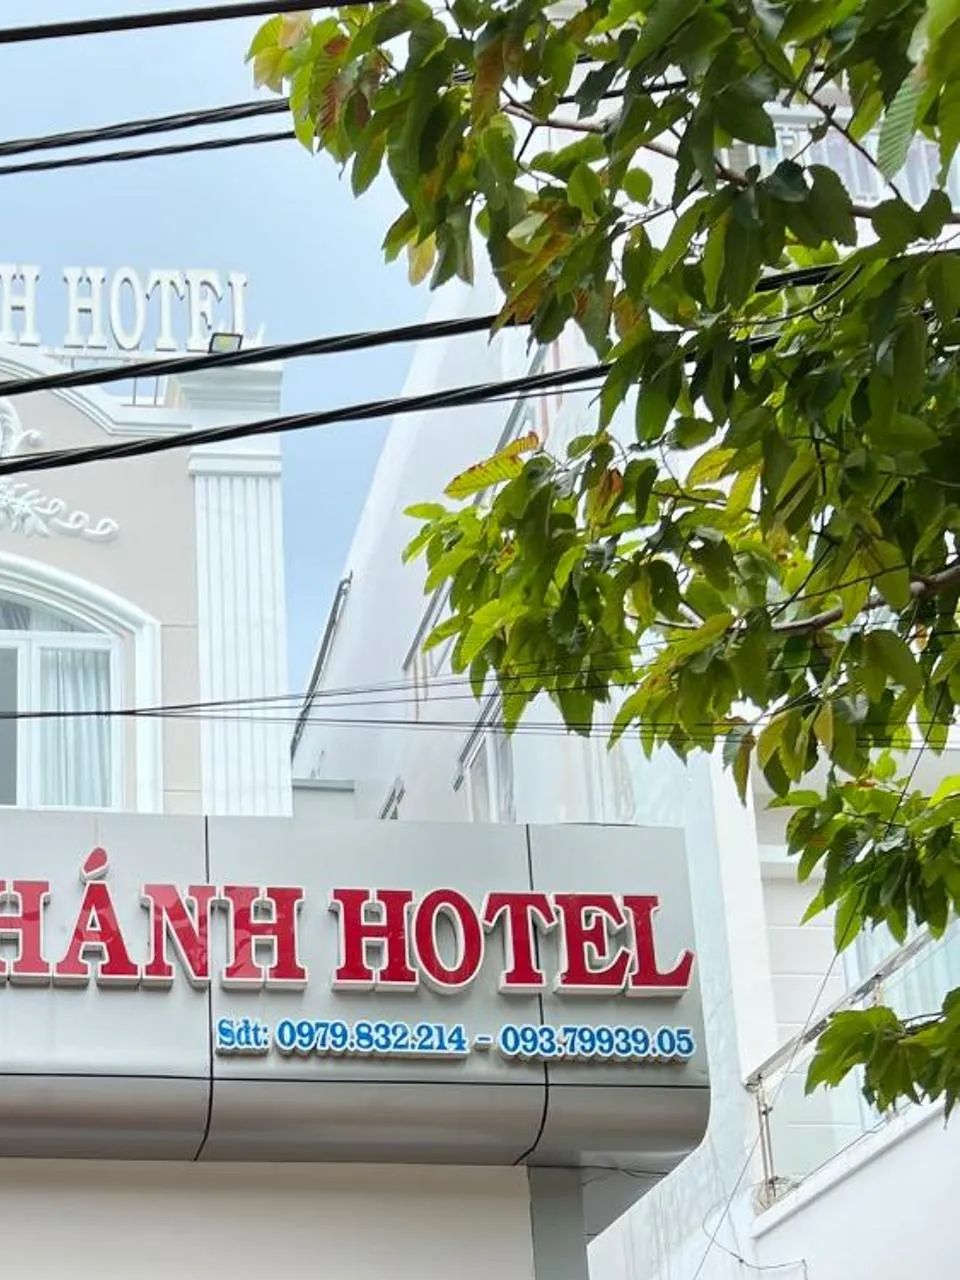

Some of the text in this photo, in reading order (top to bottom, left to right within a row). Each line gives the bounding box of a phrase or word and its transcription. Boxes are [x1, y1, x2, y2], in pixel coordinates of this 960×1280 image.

[62, 266, 266, 352] HOTEL
[331, 888, 694, 993] HOTEL
[276, 1018, 469, 1053] 0979.832.214
[500, 1024, 697, 1057] 093.79939.05
